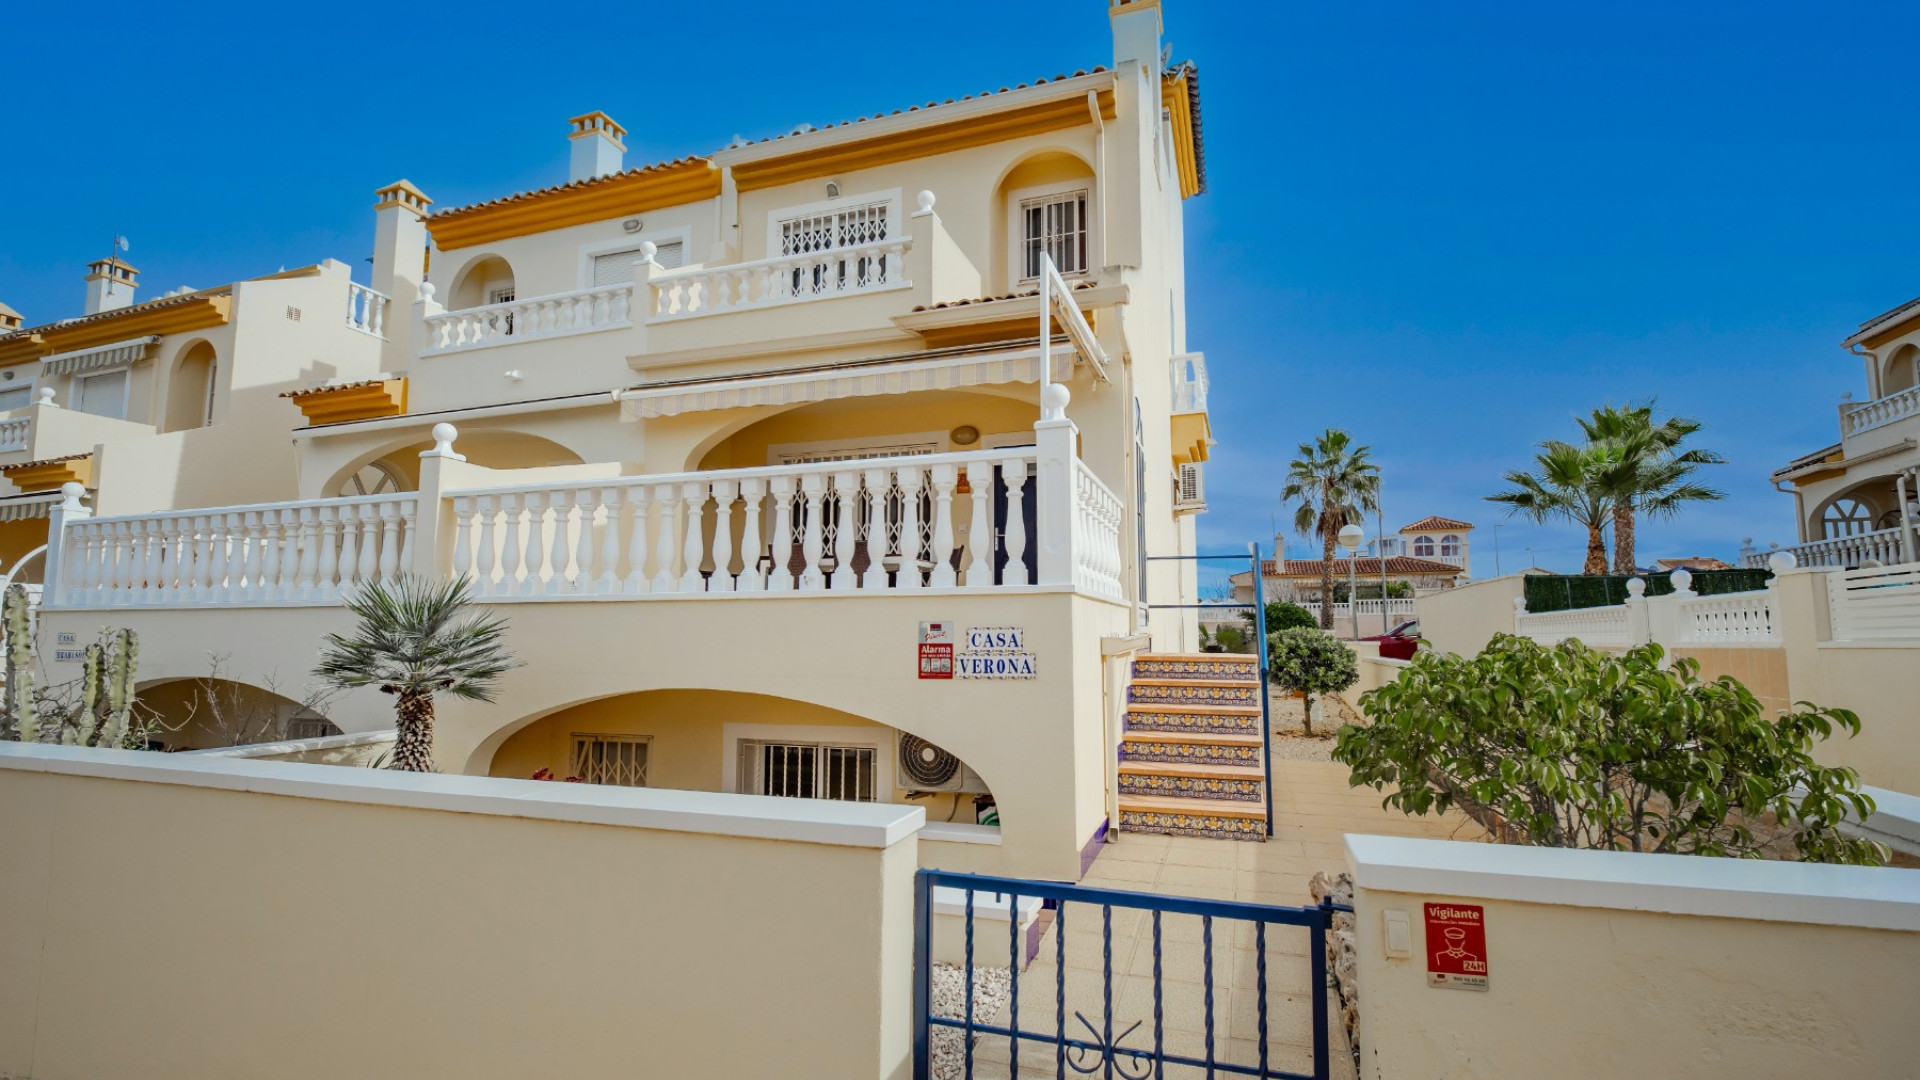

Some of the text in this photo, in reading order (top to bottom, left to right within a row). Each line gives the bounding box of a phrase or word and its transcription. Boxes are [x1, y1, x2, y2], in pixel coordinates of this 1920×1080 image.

[971, 632, 1019, 648] CASA
[921, 645, 951, 654] Alarma
[960, 658, 1032, 674] VERONA
[1428, 906, 1480, 920] Vigilante
[1465, 962, 1485, 971] 24H
